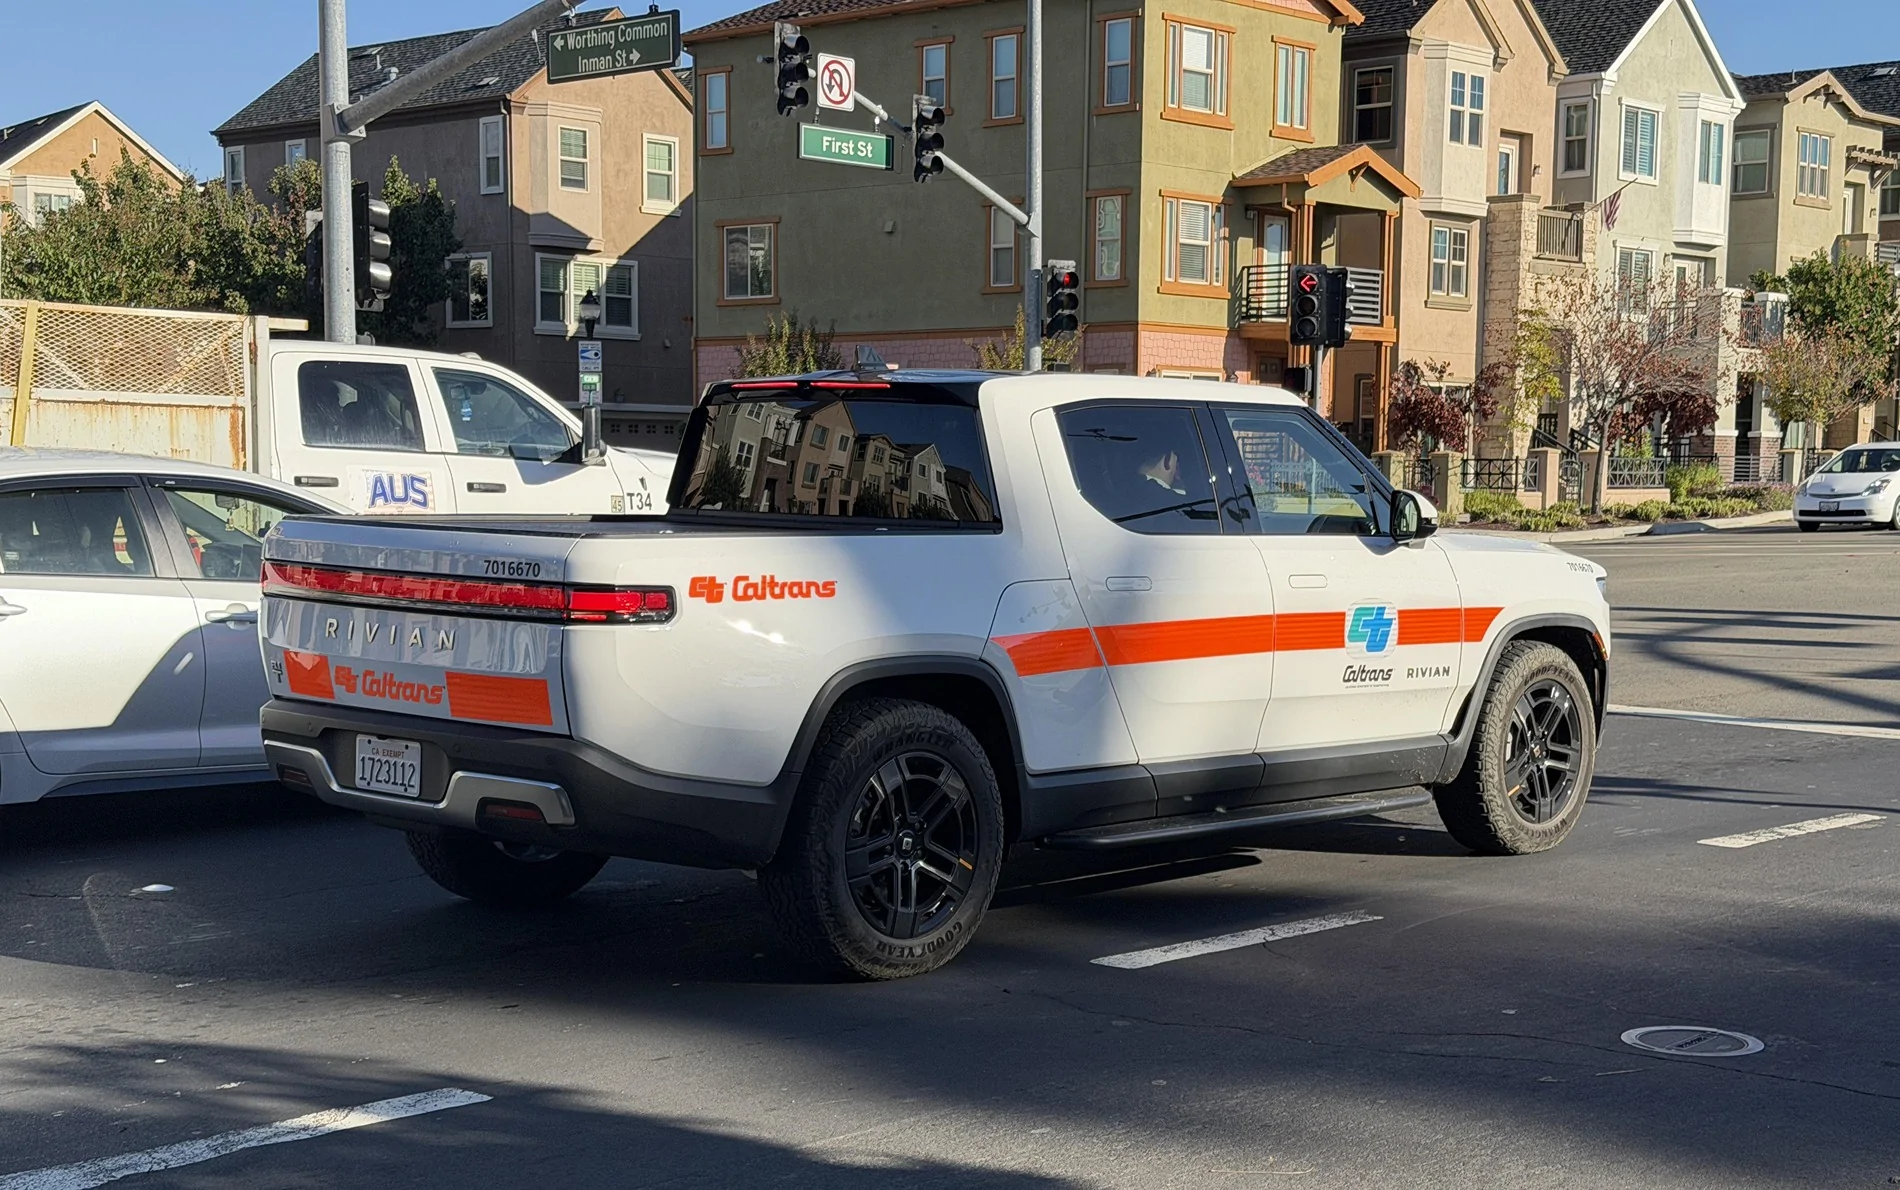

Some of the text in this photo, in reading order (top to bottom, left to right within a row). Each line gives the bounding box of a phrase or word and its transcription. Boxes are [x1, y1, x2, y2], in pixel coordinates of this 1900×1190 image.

[567, 22, 667, 50] Worthing Common
[578, 49, 627, 73] Inman St
[822, 136, 873, 158] First St
[368, 473, 430, 510] AUS
[626, 492, 652, 511] T34
[483, 559, 541, 578] 7016670
[732, 574, 836, 602] Caltrans
[325, 618, 456, 650] RIVIAN
[1342, 664, 1394, 683] Caltrans
[1406, 666, 1450, 679] RIVIAN
[362, 670, 443, 705] Caltrans
[371, 747, 405, 759] CA EXEMPT
[359, 756, 416, 788] 1723112
